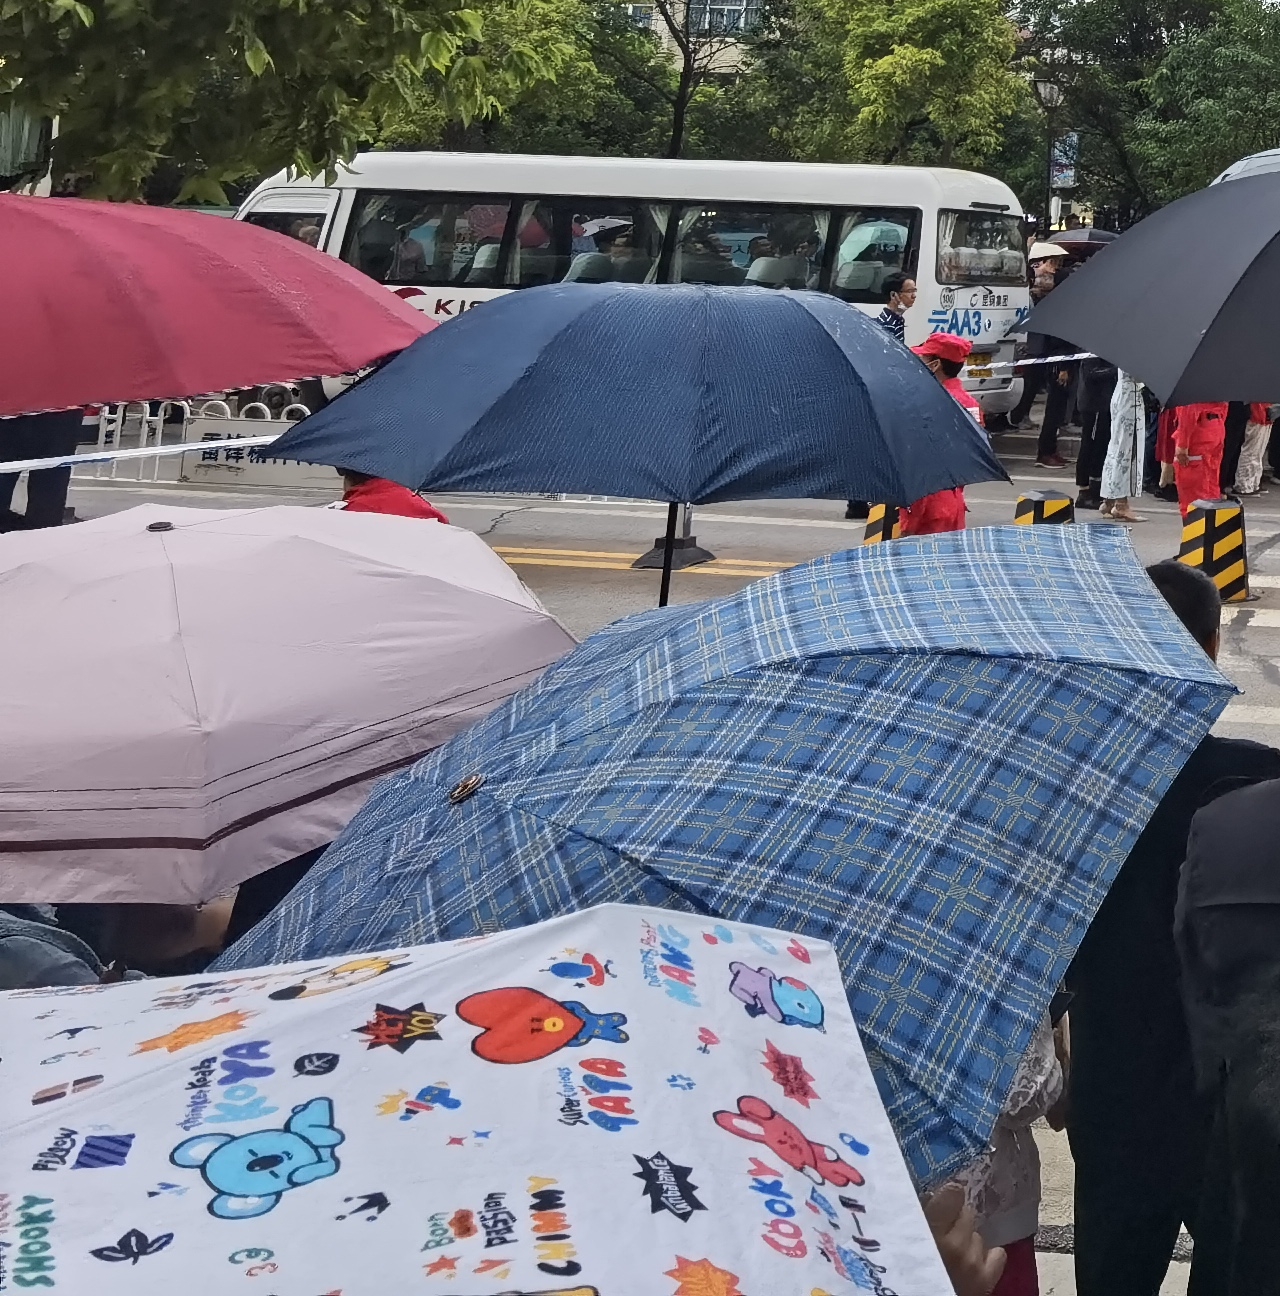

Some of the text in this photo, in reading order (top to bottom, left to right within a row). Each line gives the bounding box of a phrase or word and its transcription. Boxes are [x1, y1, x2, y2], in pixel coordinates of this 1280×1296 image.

[927, 308, 982, 337] 云AA3
[657, 923, 702, 1008] MANG
[204, 1040, 279, 1124] KOYA
[578, 1057, 639, 1132] TATA
[32, 1127, 79, 1172] Pillow
[12, 1195, 56, 1288] SHOOKY
[527, 1175, 582, 1277] CHIMMY
[747, 1157, 808, 1259] COOKY
